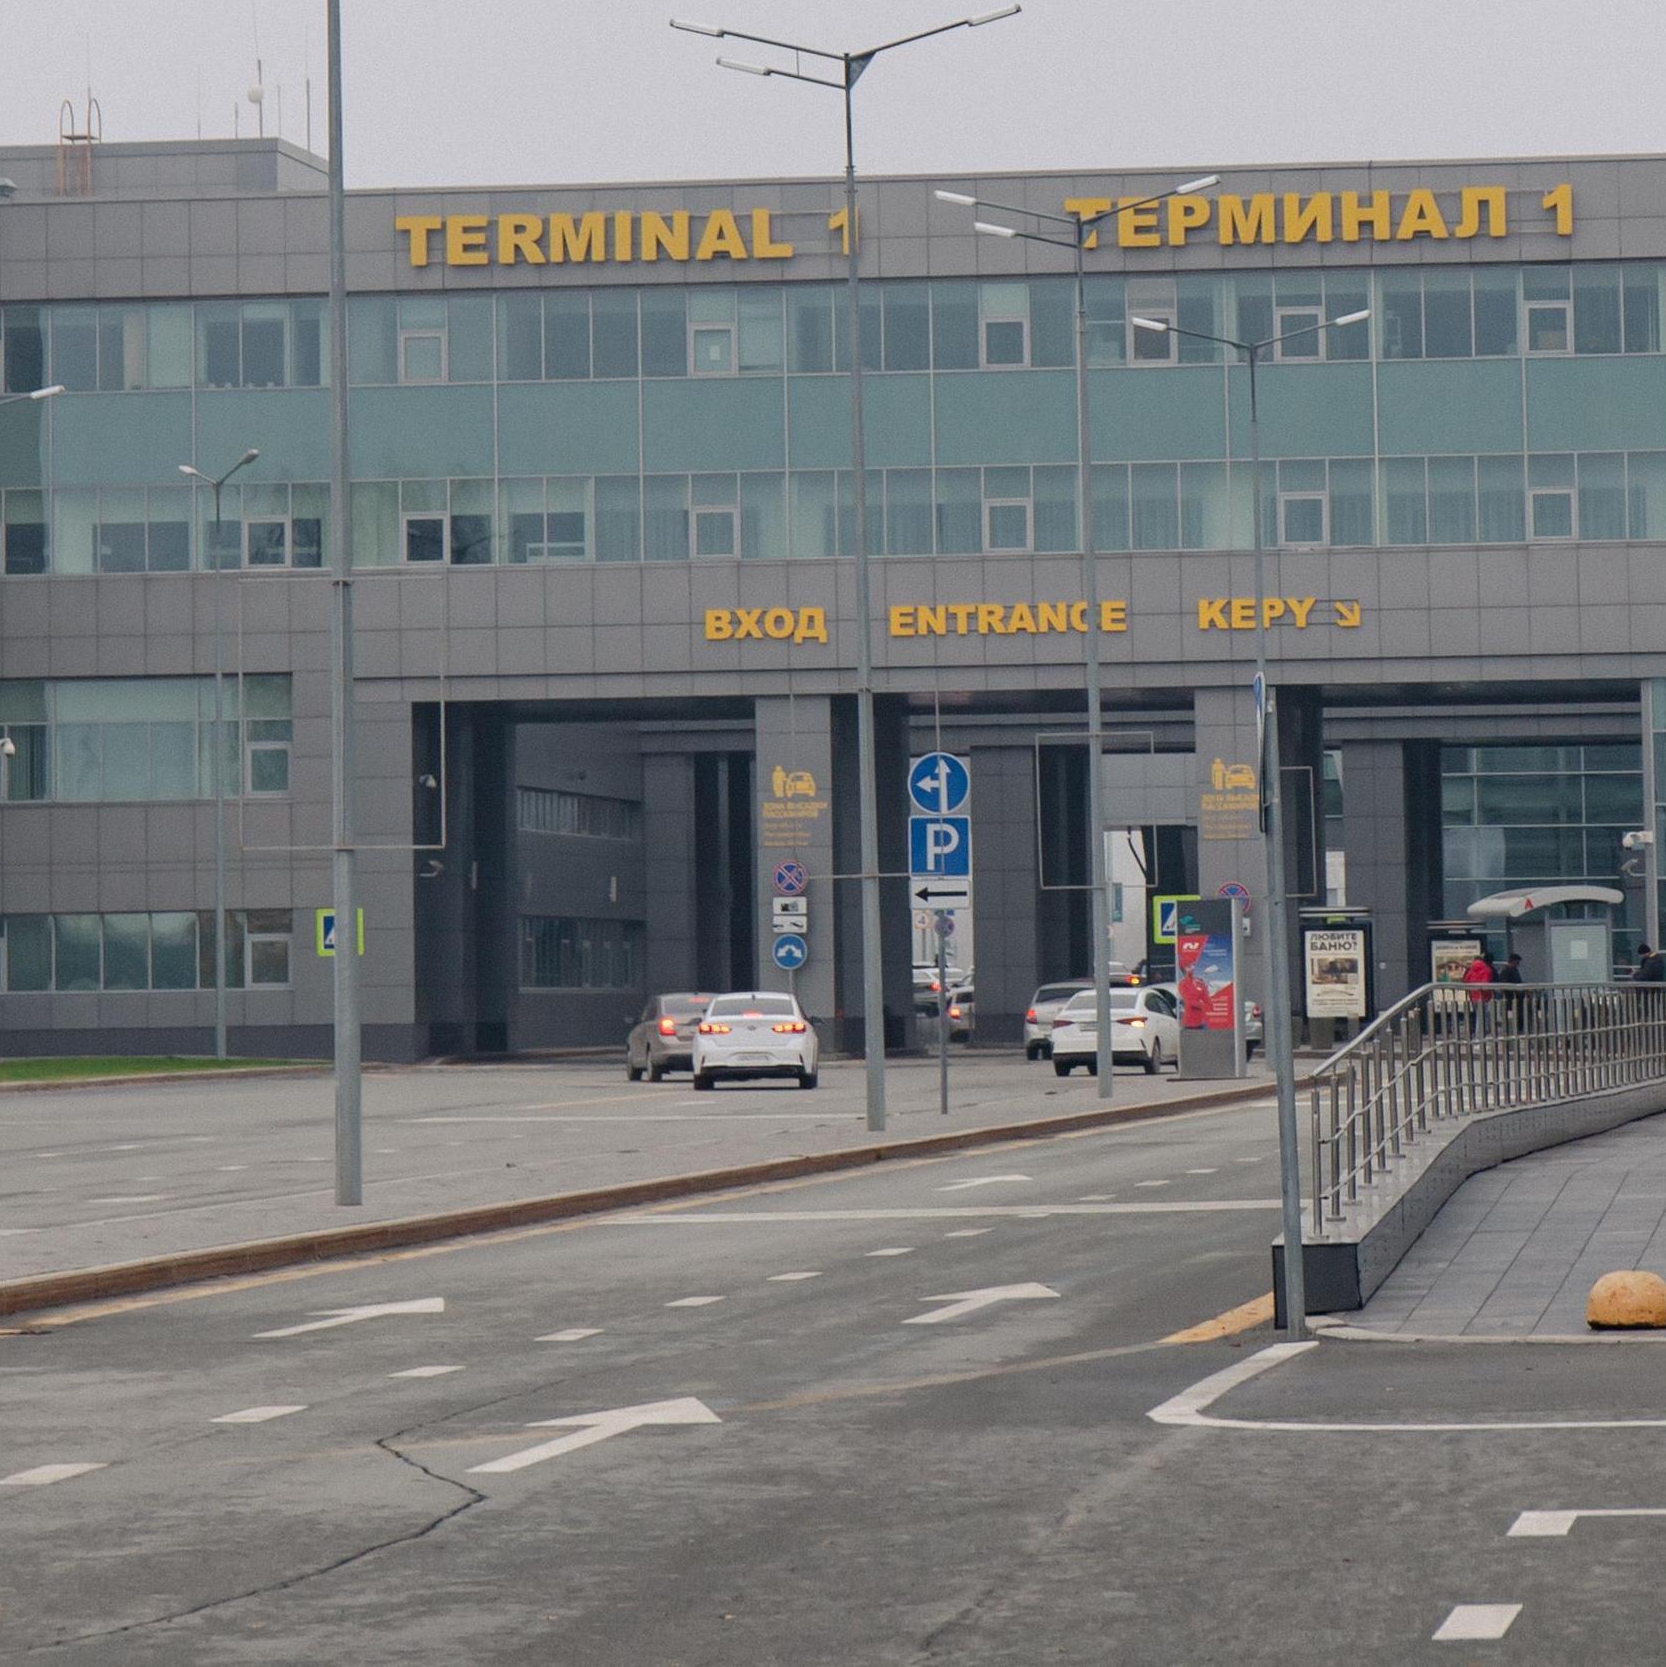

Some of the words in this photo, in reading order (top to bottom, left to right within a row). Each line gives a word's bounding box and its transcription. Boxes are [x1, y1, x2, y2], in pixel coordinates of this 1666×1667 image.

[395, 207, 794, 266] TERMINAL
[828, 205, 860, 256] 1
[1063, 185, 1508, 249] ТЕРМИНАЛ
[1541, 183, 1573, 237] 1
[704, 605, 829, 644] ВХОД
[889, 600, 1128, 637] ENTRANCE
[1197, 596, 1316, 630] КЕРУ
[926, 823, 960, 871] P
[1310, 932, 1358, 941] ЛЮБИТЕ
